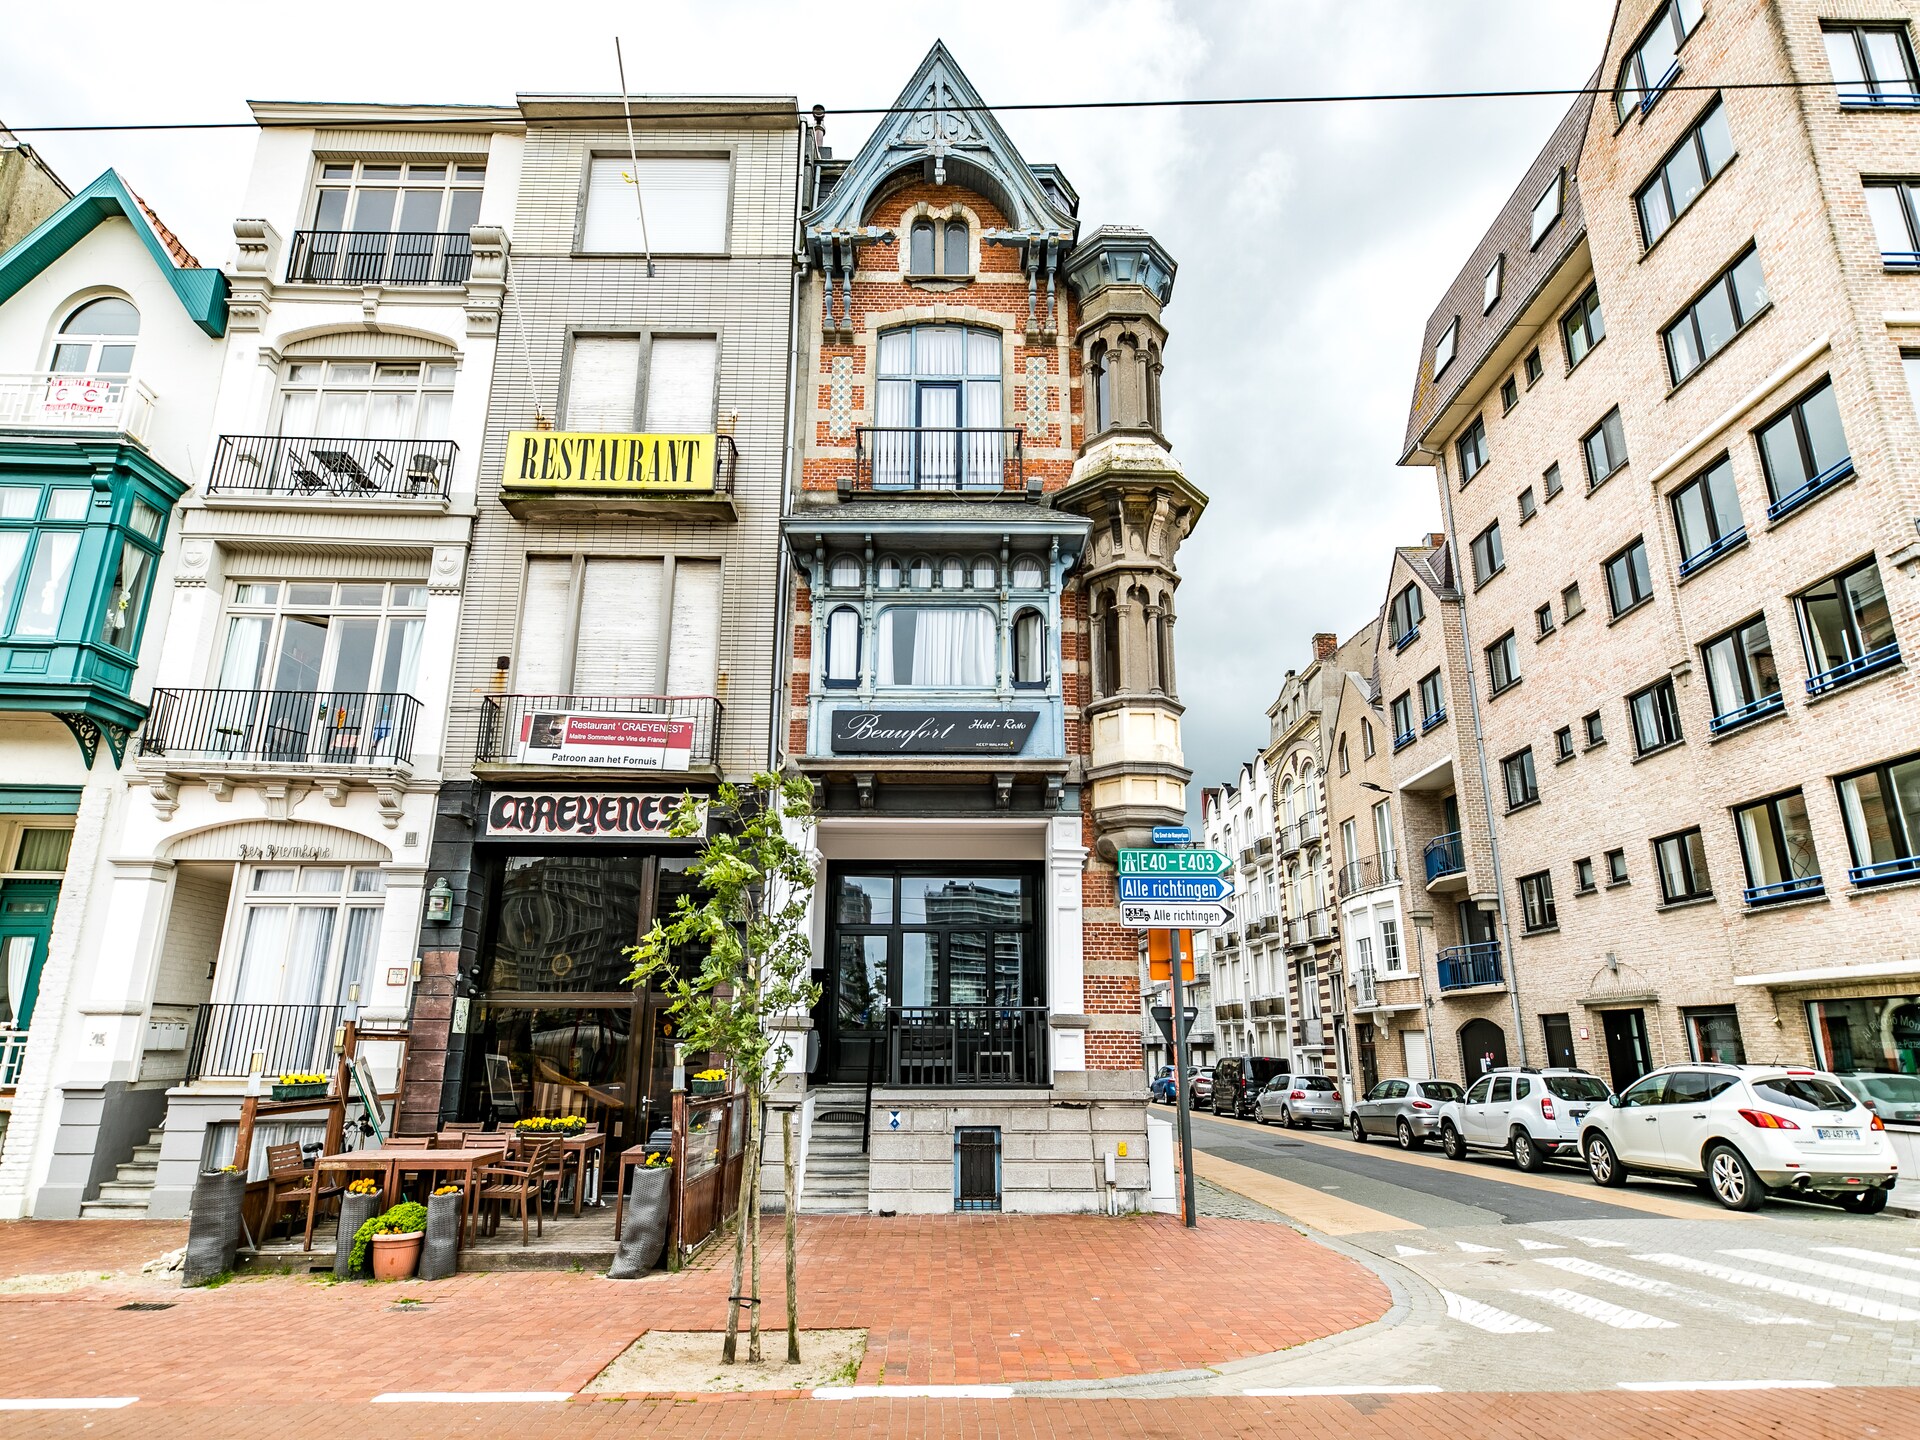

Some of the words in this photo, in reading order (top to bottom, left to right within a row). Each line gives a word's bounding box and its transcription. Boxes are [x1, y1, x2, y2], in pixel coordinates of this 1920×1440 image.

[518, 437, 700, 482] RESTAURANT
[571, 720, 616, 730] Restaurant
[837, 713, 956, 749] Beaufort
[968, 718, 996, 729] Hotel
[1003, 718, 1027, 730] Resto
[551, 753, 586, 762] Patroon
[607, 755, 621, 764] het
[623, 756, 657, 765] Fornuis
[1125, 879, 1149, 897] Alle
[1153, 879, 1217, 901] richtingen
[1154, 909, 1171, 921] Alle
[1173, 909, 1220, 924] richtingen
